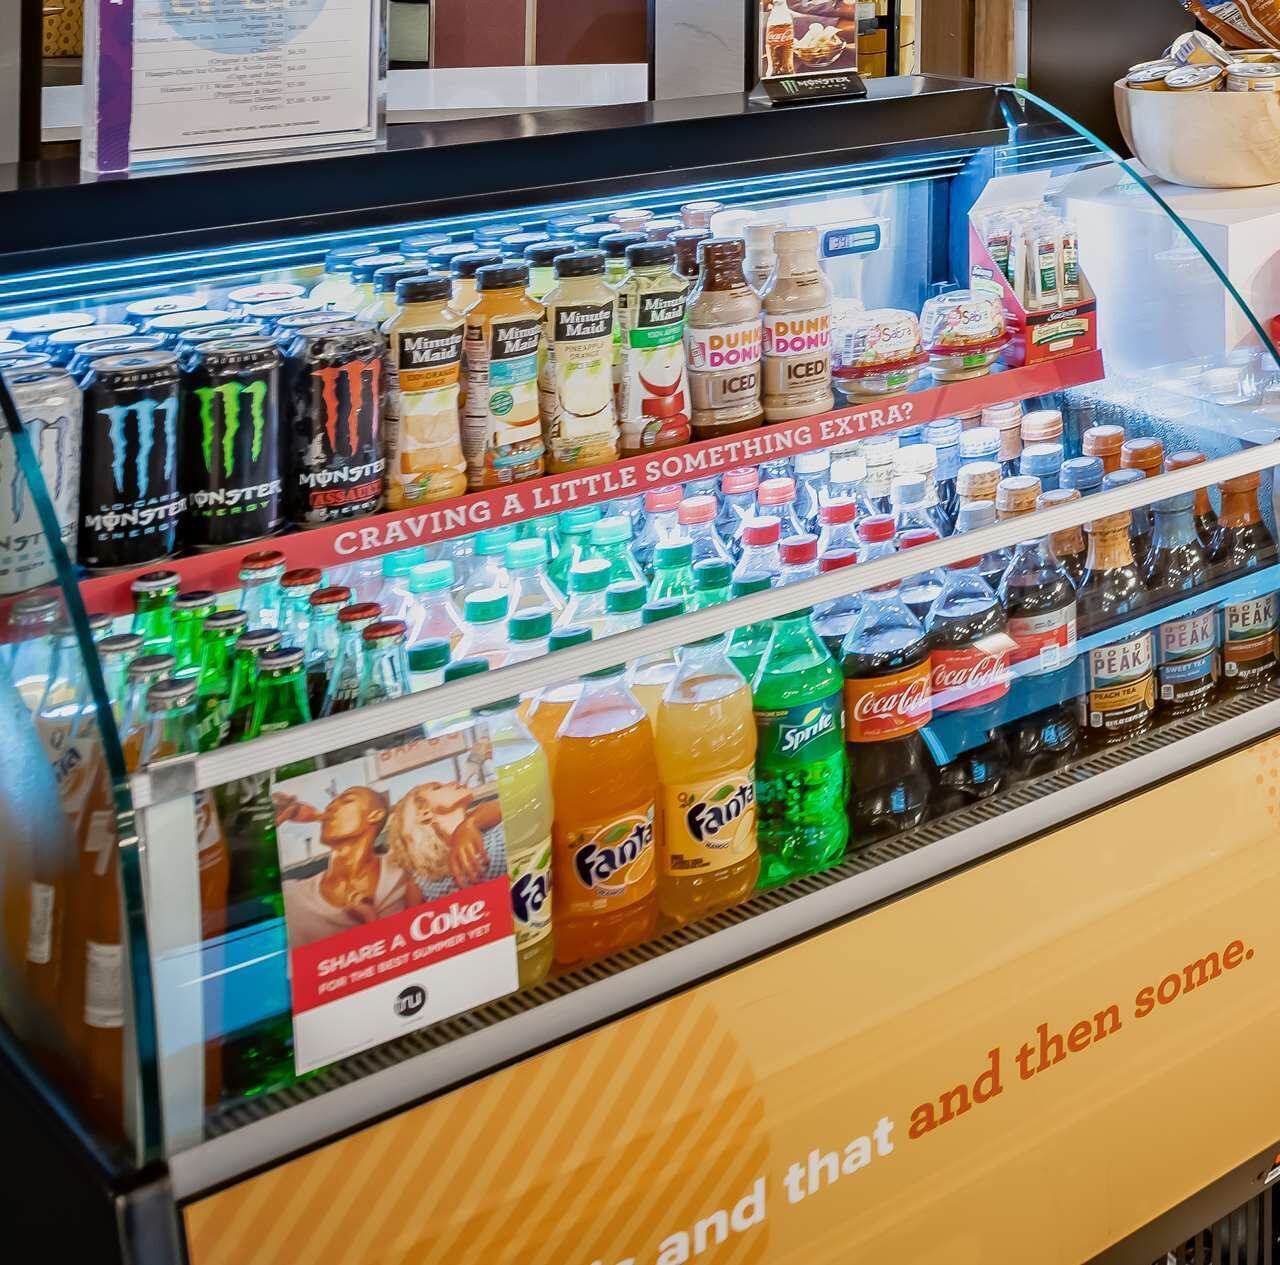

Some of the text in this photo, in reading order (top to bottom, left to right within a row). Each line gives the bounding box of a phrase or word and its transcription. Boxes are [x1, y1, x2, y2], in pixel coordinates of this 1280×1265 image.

[559, 309, 610, 324] Minute
[650, 308, 683, 322] Maid
[565, 321, 607, 336] Maid
[404, 334, 462, 351] Minute
[504, 336, 538, 354] Maid
[412, 346, 457, 364] Maid
[722, 373, 757, 394] ICED
[333, 400, 914, 557] CRAVING A LITTLE SOMETHING EXTRA?
[98, 520, 180, 541] ENERGY
[1229, 605, 1273, 628] PEAK
[1166, 625, 1210, 649] PEAK
[1094, 643, 1141, 658] GOLD
[1094, 651, 1145, 675] PEAK
[1166, 659, 1206, 674] SWEET TEA
[1094, 687, 1137, 700] PEACH TEA
[781, 710, 833, 753] Sprite
[686, 783, 754, 842] Fanta
[317, 900, 486, 977] SHARE A Coke
[318, 923, 492, 995] FOR THE BEST SUMMER YET
[656, 938, 1256, 1265] and that and then some.
